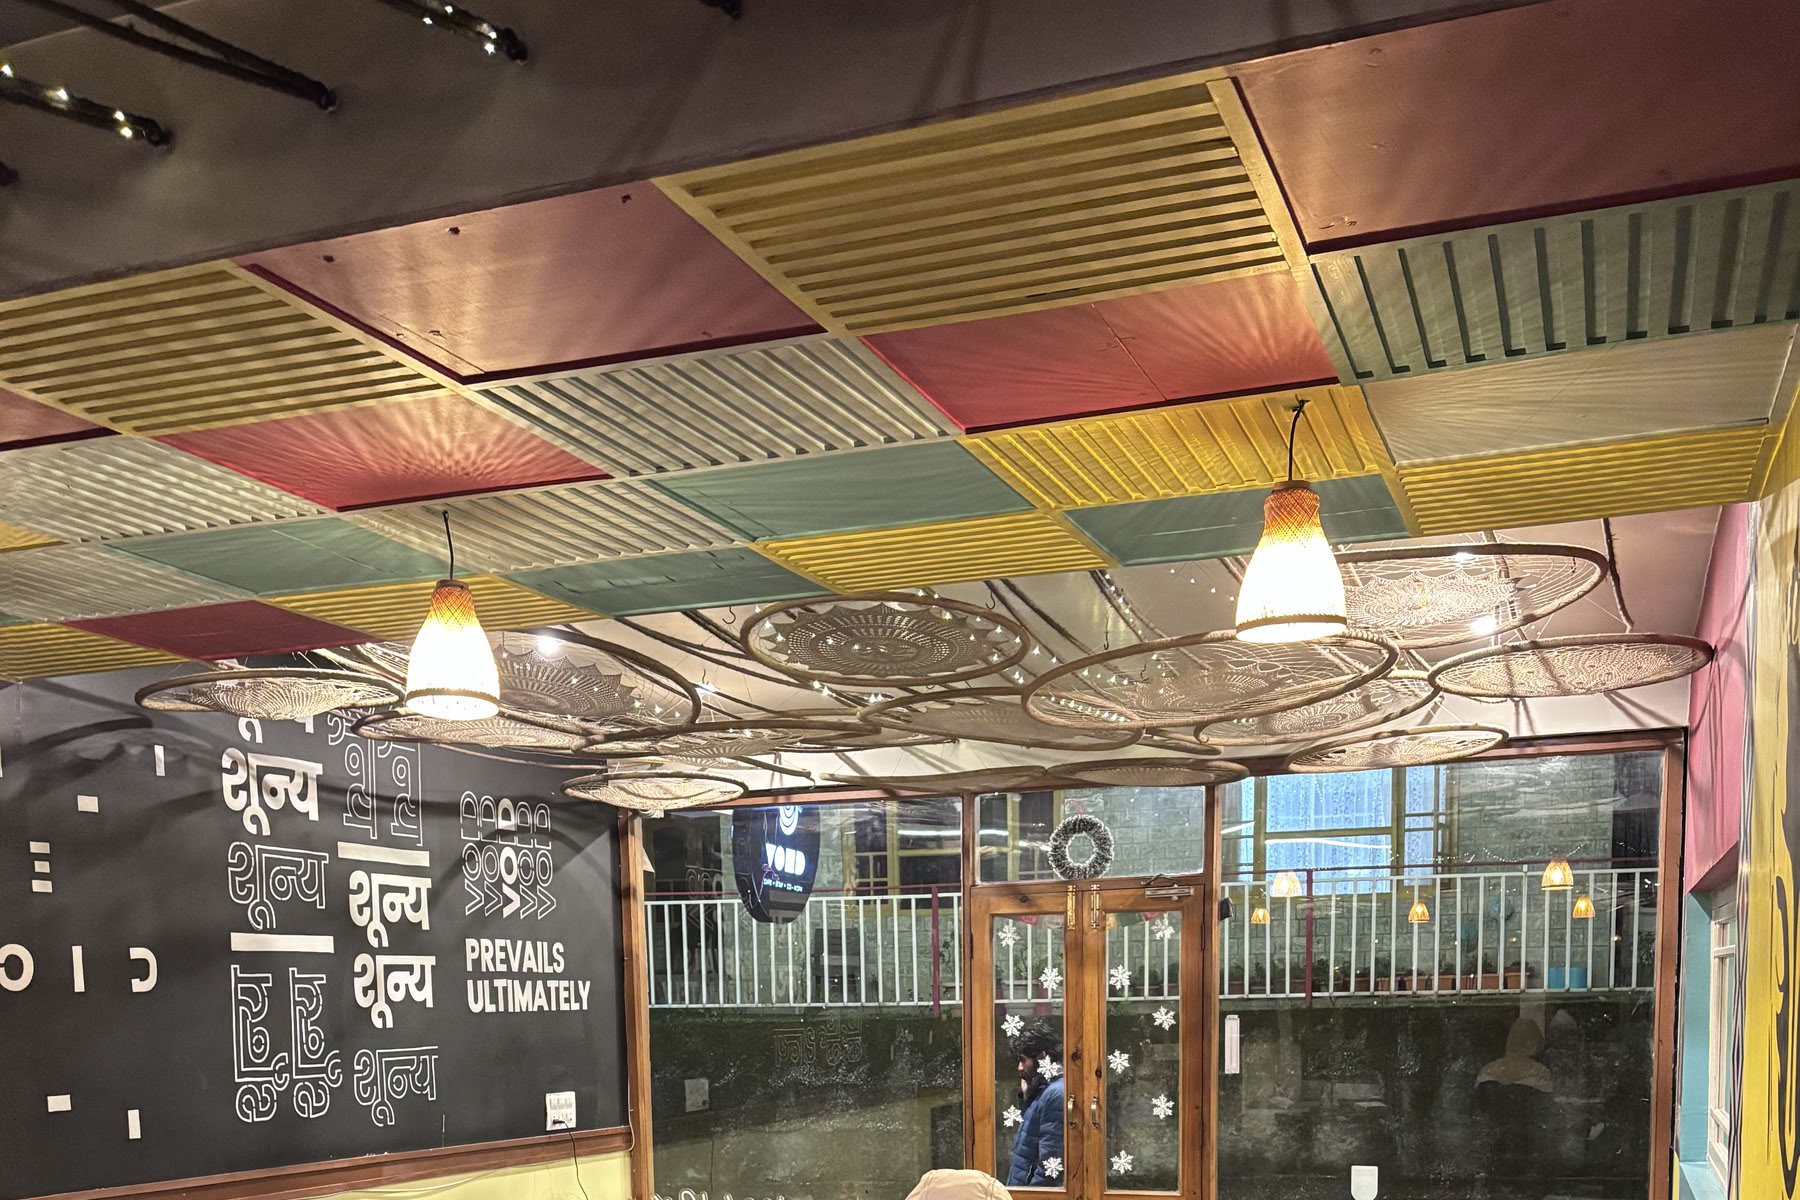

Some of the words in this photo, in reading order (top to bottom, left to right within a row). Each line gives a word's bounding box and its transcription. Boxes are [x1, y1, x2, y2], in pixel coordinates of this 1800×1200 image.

[221, 747, 323, 836] शून्य
[228, 841, 329, 930] शून्य
[765, 843, 806, 876] VOID
[348, 870, 432, 947] शून्य
[353, 953, 436, 1028] शून्य
[465, 938, 565, 974] PREVAILS
[467, 979, 591, 1013] ULTIMATELY
[353, 1046, 438, 1127] शून्य
